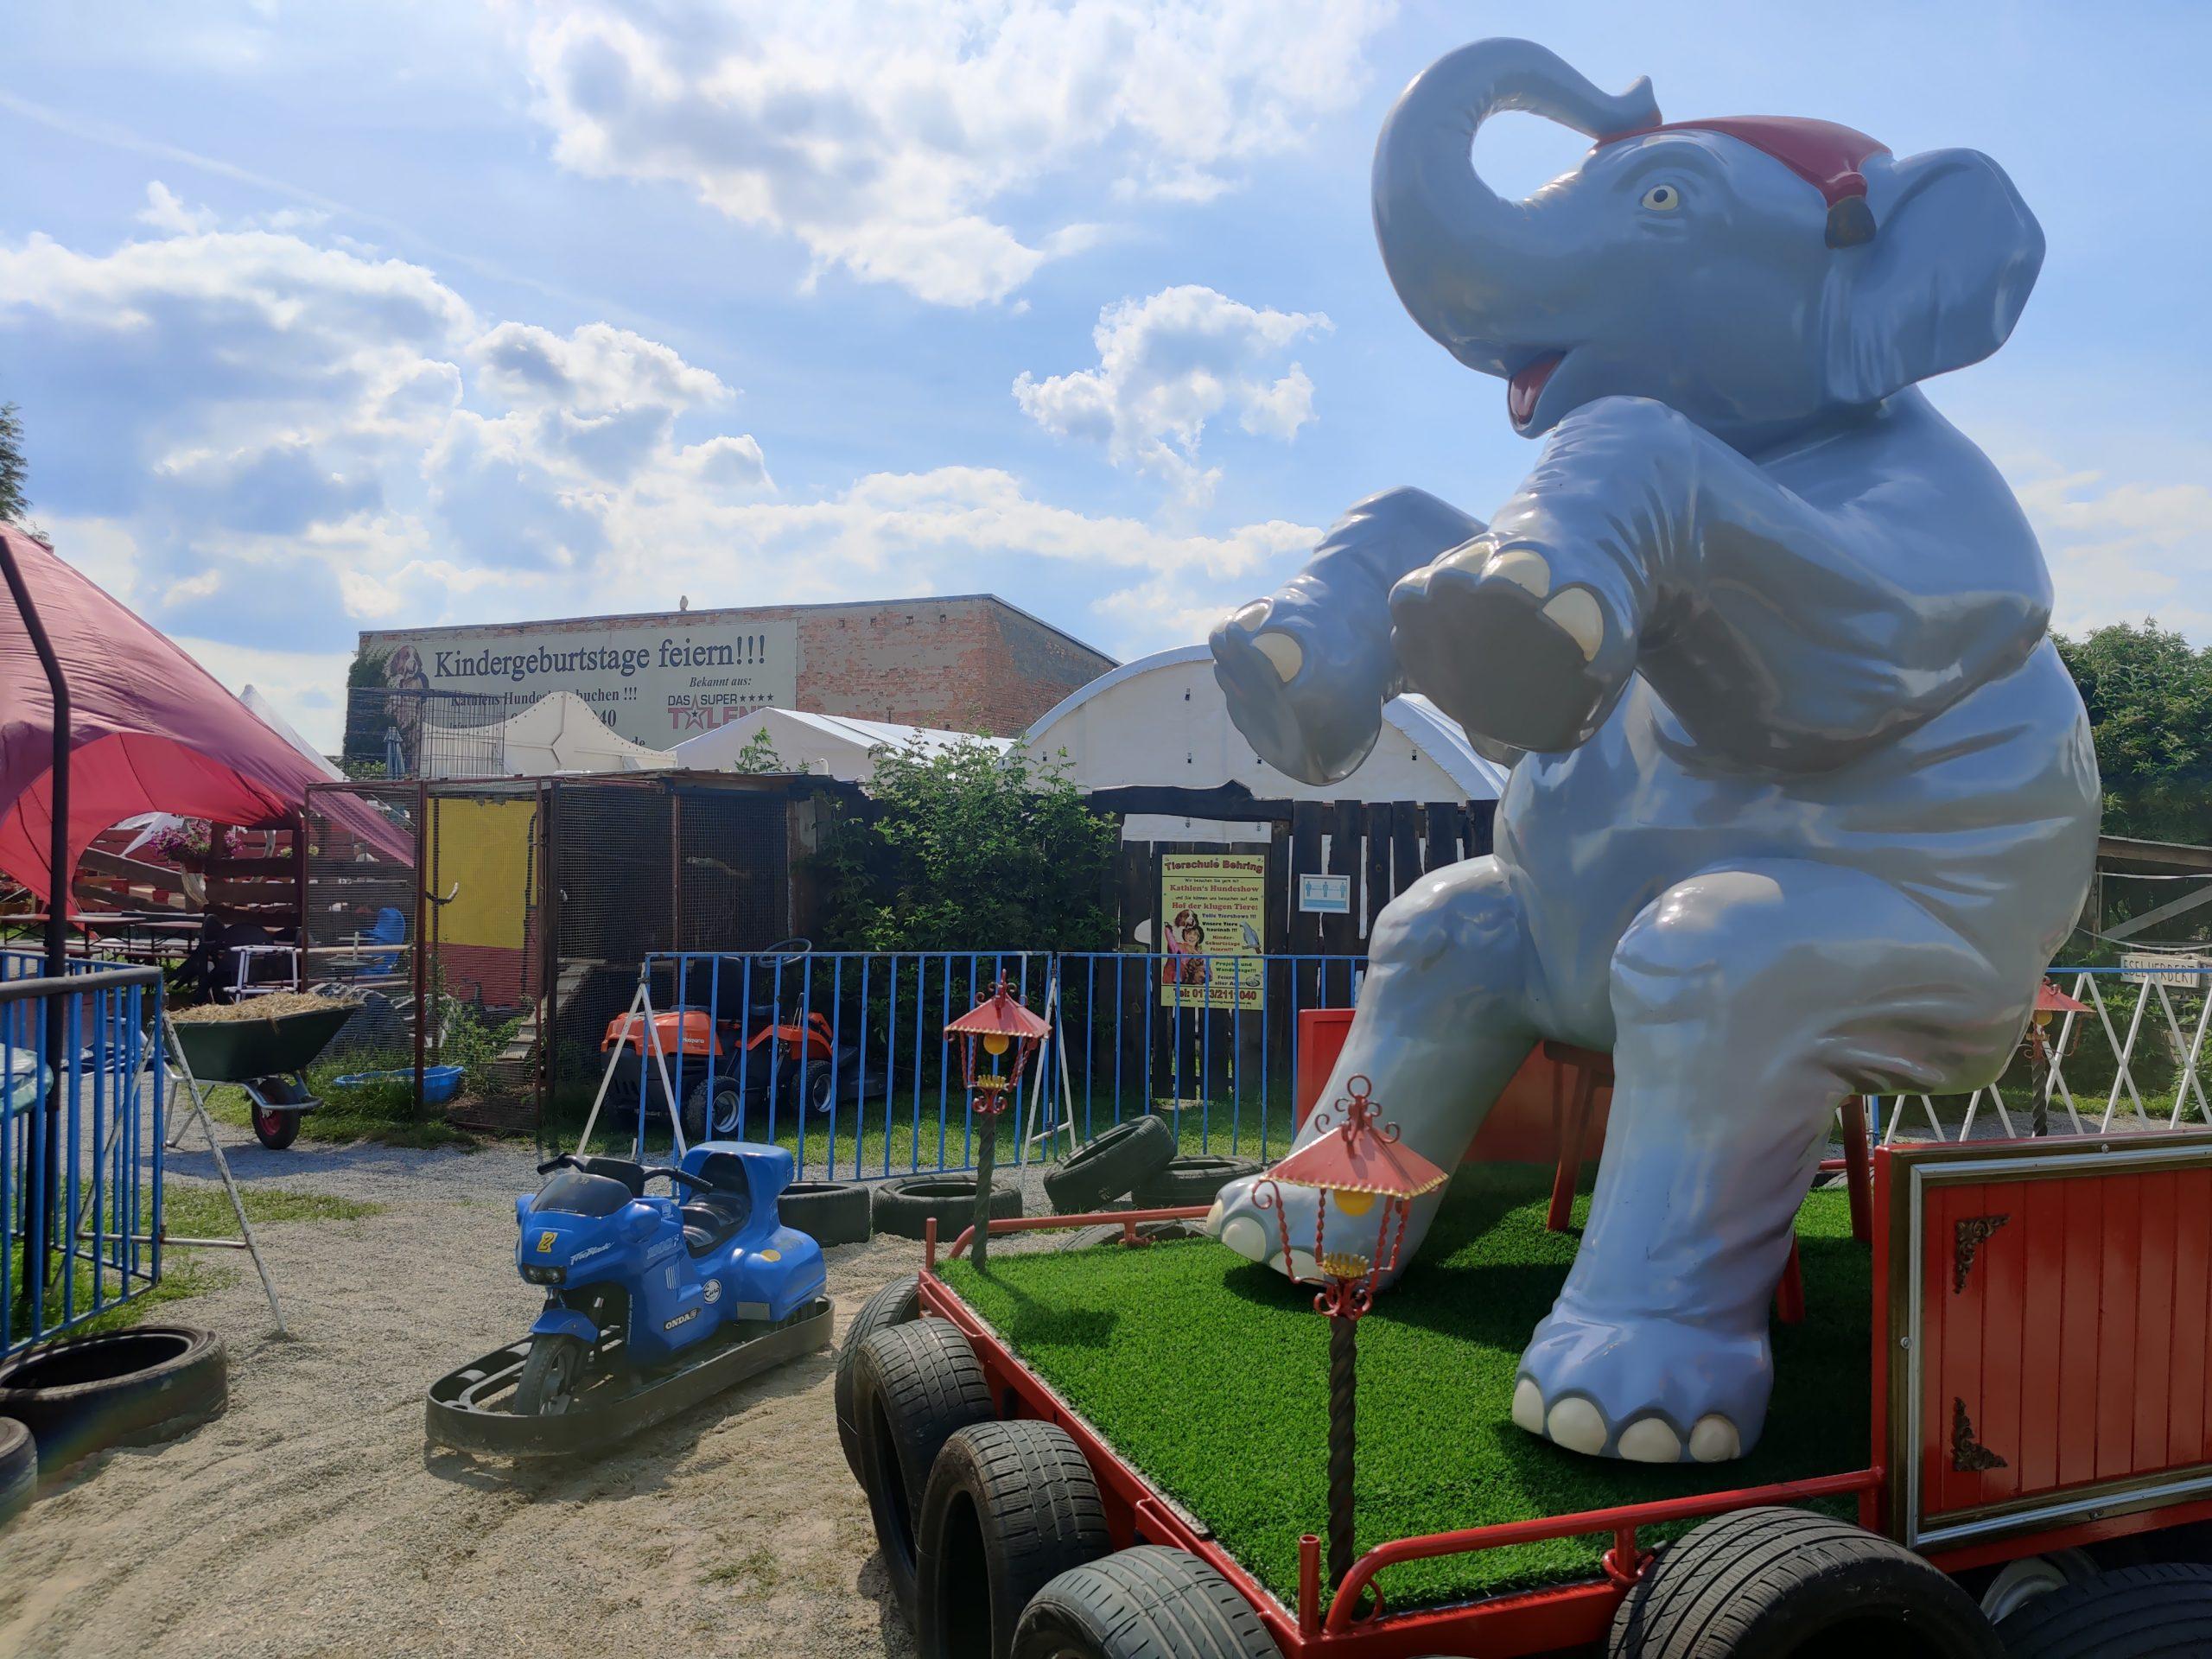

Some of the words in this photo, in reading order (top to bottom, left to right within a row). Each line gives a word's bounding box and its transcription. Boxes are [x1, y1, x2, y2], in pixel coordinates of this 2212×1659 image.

[435, 645, 650, 682] Kindergeburtstage
[658, 634, 766, 667] feiern!!!
[690, 677, 728, 688] Bekannt
[732, 677, 752, 687] aus:
[624, 686, 638, 701] !!!
[668, 694, 690, 706] DAS
[701, 693, 738, 705] SUPER
[1165, 861, 1219, 870] Tierschule
[1223, 860, 1263, 874] Behring
[1204, 903, 1232, 912] klugen
[2123, 959, 2146, 978] ESEL
[537, 1233, 555, 1251] 2
